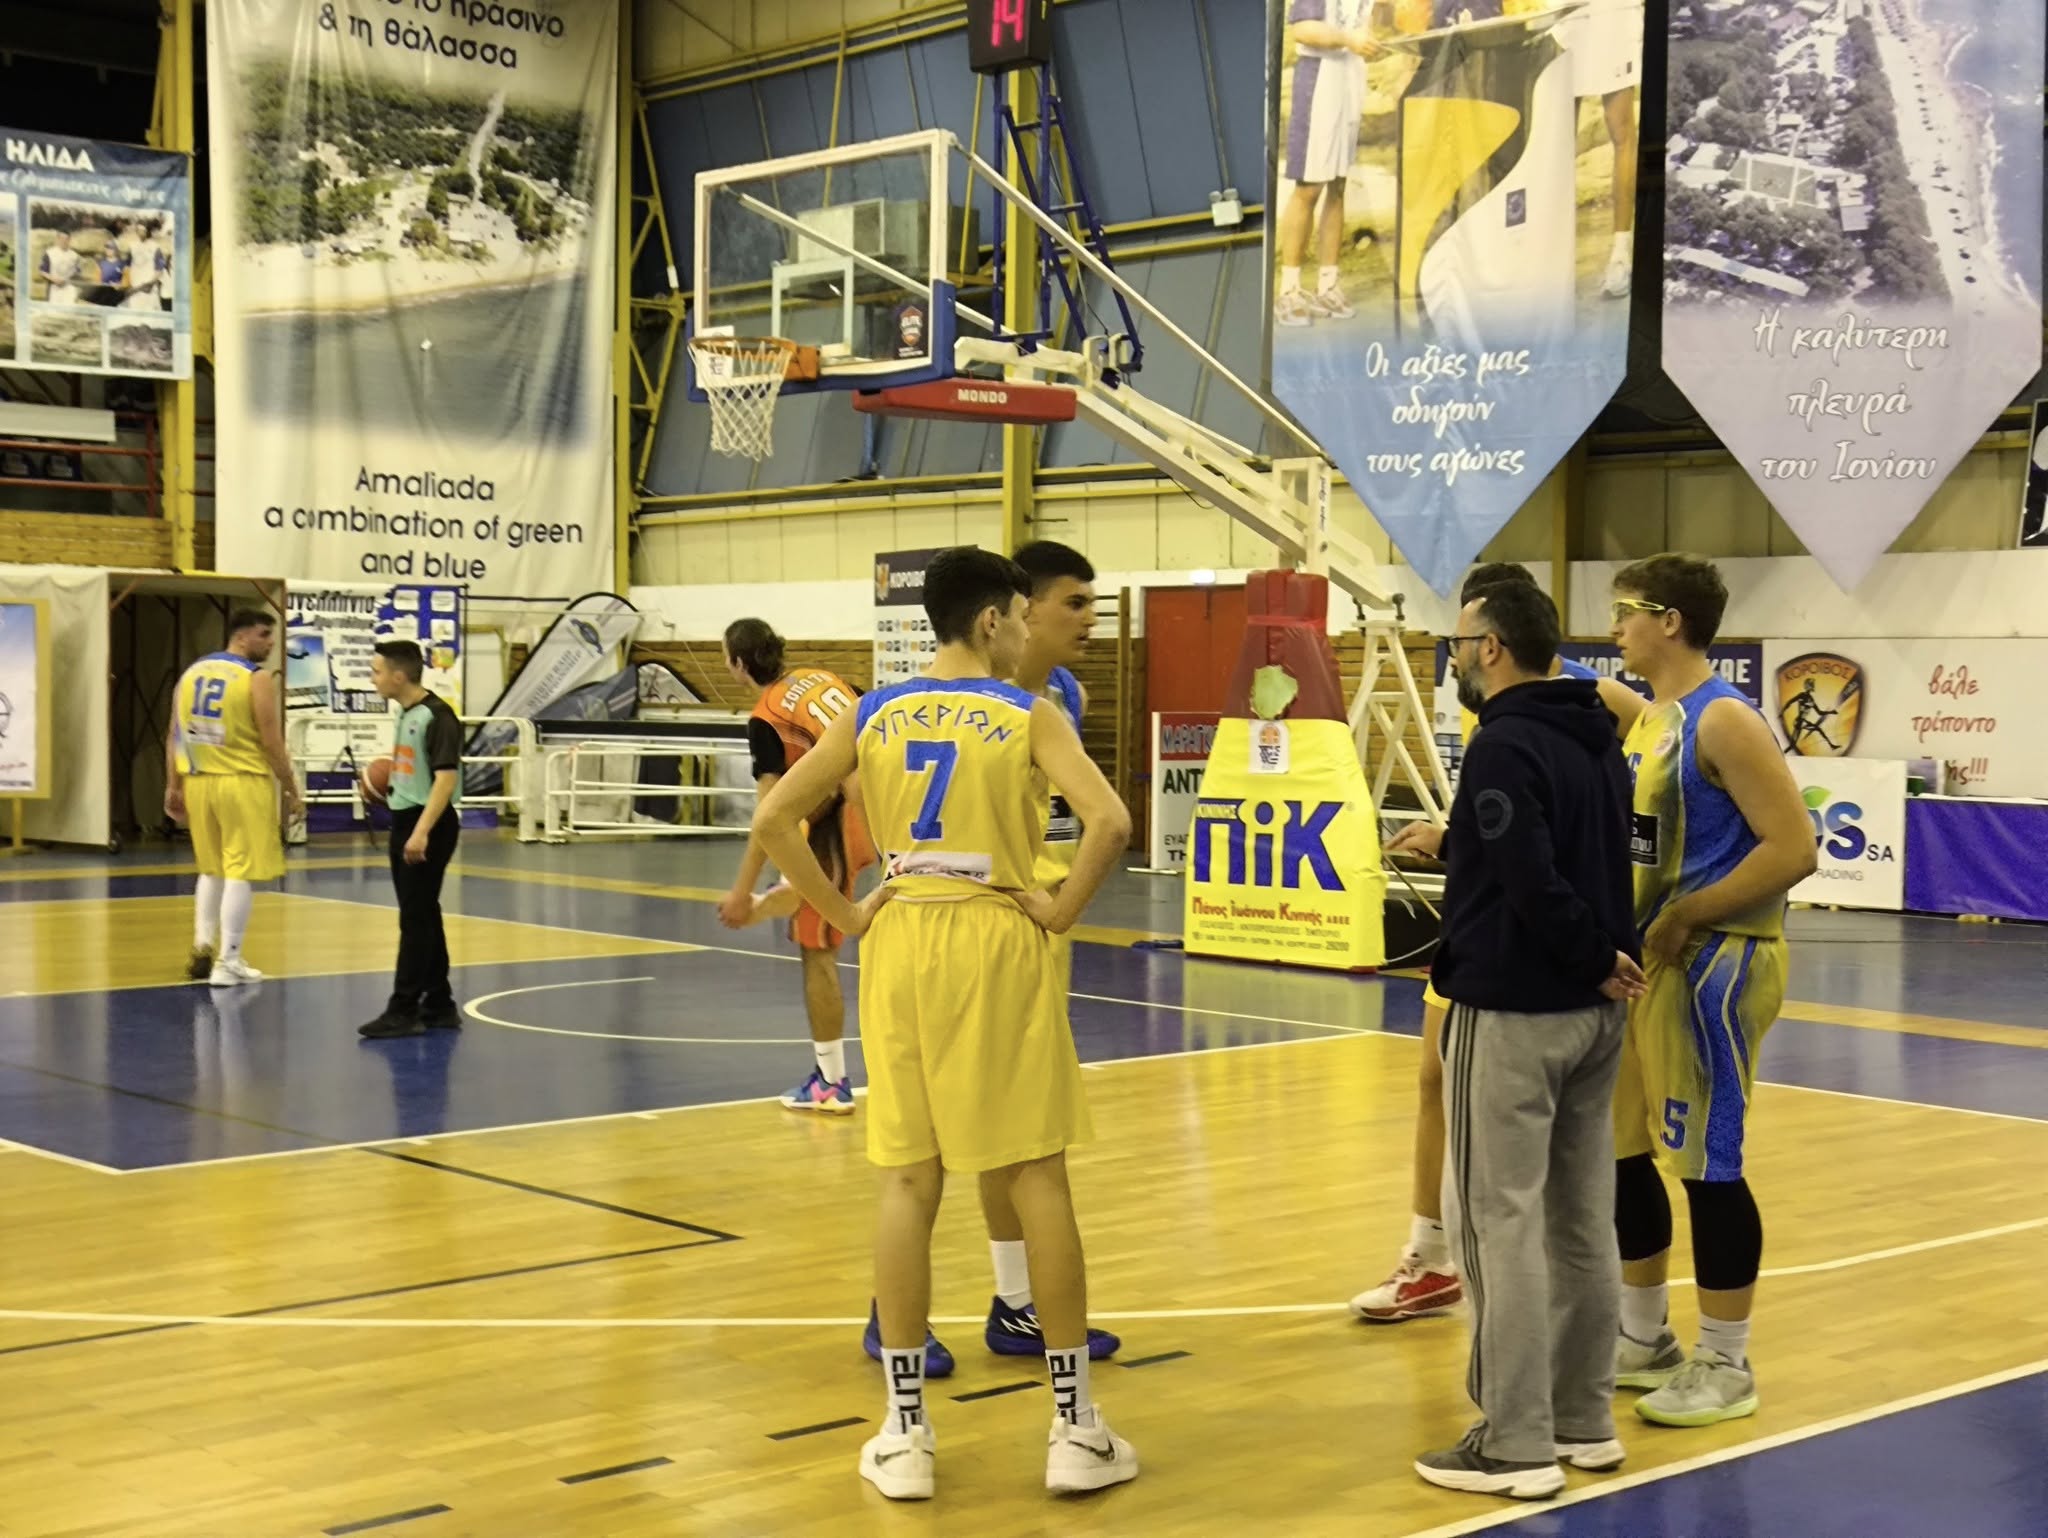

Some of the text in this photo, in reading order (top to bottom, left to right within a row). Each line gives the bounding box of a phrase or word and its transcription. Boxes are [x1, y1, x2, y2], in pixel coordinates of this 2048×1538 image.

[318, 3, 338, 31] &
[384, 18, 518, 69] θάλασσα
[991, 0, 1025, 47] 14
[5, 137, 96, 173] ΗΛΙΔΑ
[1753, 304, 1950, 371] Η καλύτερη
[1366, 341, 1390, 378] Οι
[1476, 350, 1530, 388] μας
[957, 388, 1008, 404] MONDO
[1391, 385, 1496, 439] οδηγούν
[1787, 378, 1912, 436] πλευρά
[1367, 442, 1525, 487] τους αγώνες
[1760, 440, 1937, 482] του Ιονίου
[355, 465, 495, 501] Amaliada
[264, 505, 583, 549] a combination of green
[361, 550, 487, 579] and blue
[1784, 661, 1850, 682] ΚΟΡΟΙΒΟΣ
[1928, 664, 1980, 699] βάλε
[191, 676, 226, 719] 12
[808, 686, 854, 730] 10
[1911, 710, 1996, 743] τρίποντο
[905, 739, 959, 841] 7
[1944, 757, 1989, 785] ής!!!
[1815, 868, 1864, 881] RADING
